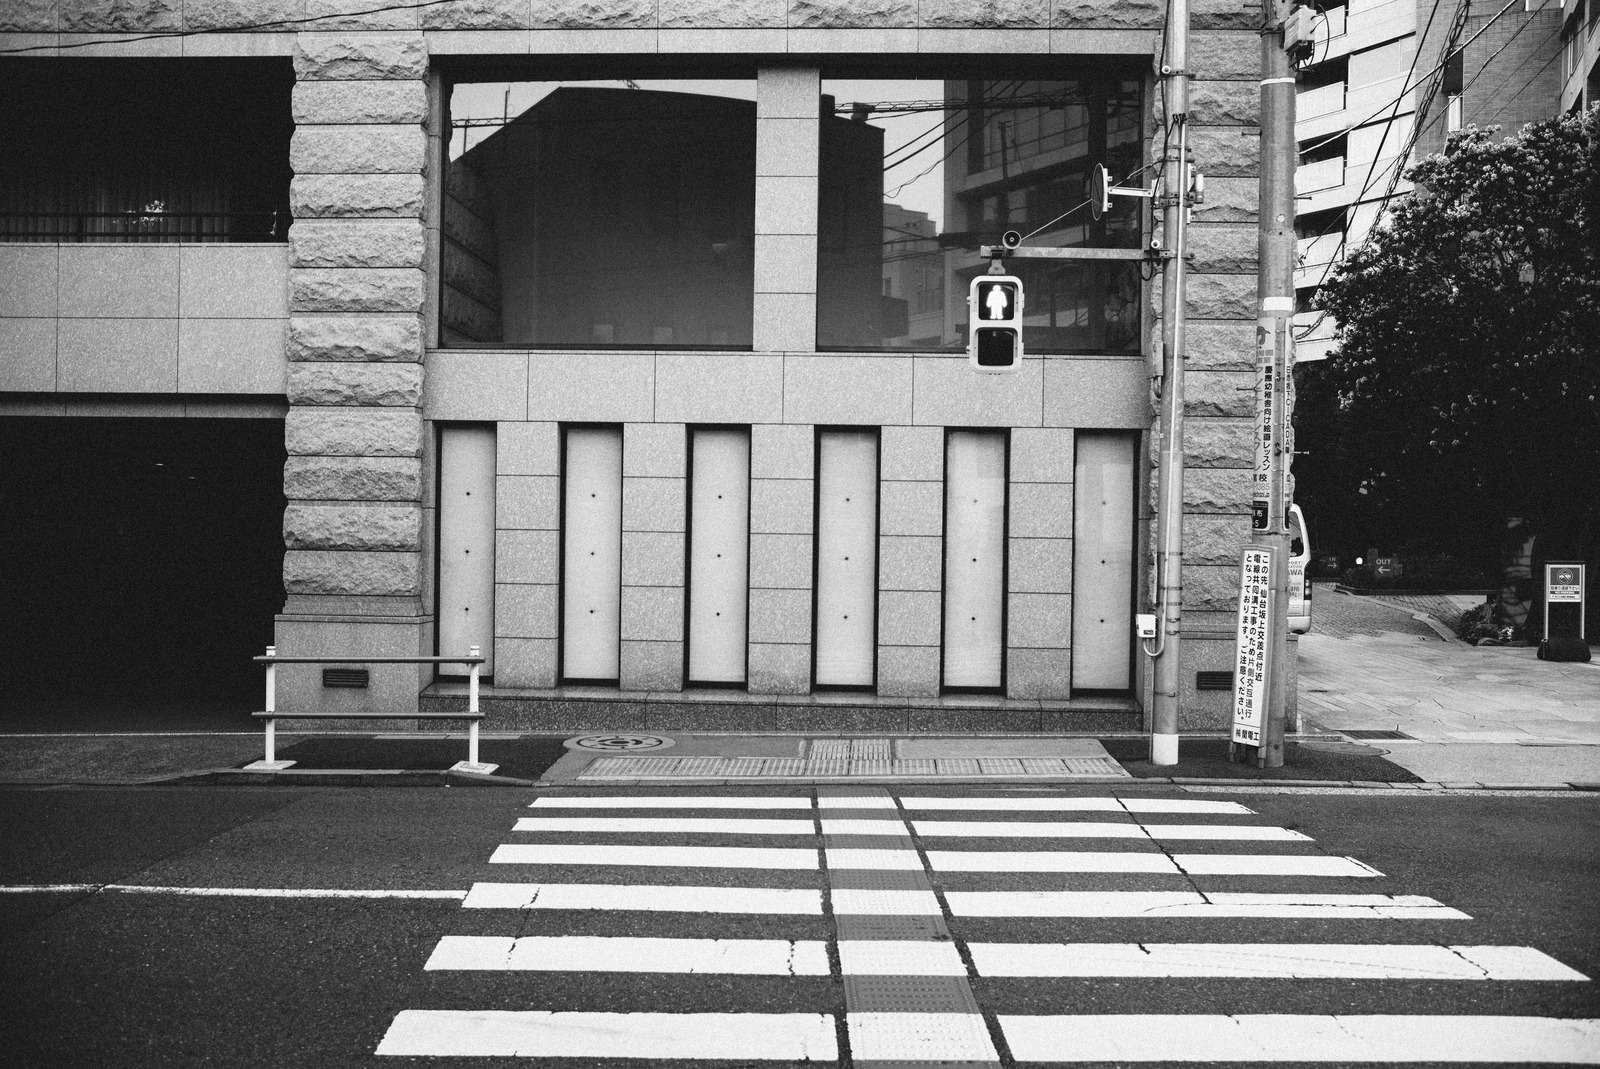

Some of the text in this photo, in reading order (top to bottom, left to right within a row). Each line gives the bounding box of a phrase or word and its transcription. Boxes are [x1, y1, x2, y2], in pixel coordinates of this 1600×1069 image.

[1254, 555, 1269, 682] この先 仙台坂上交差点付近
